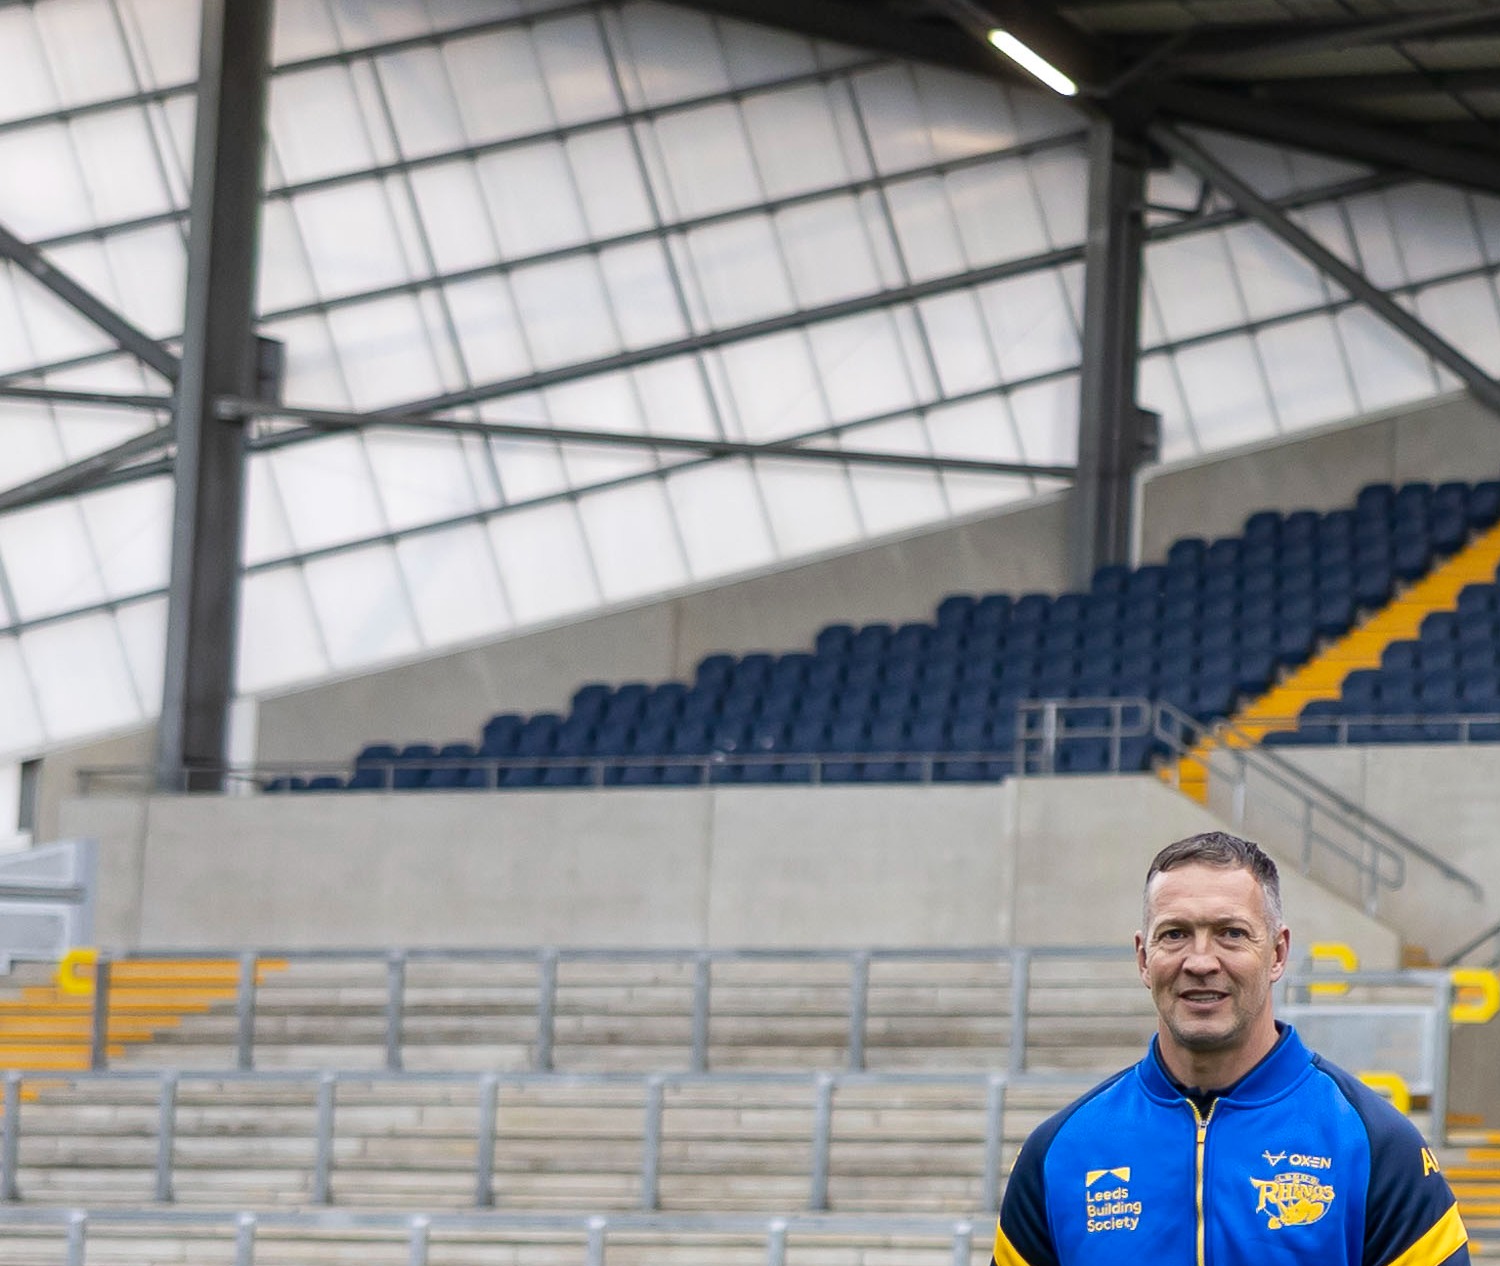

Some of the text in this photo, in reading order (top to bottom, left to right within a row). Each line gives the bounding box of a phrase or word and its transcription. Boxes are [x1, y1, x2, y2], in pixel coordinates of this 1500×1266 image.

[1289, 1154, 1332, 1168] OXEN
[1086, 1187, 1129, 1202] Leeds
[1087, 1201, 1142, 1217] Building
[1087, 1216, 1139, 1232] Society
